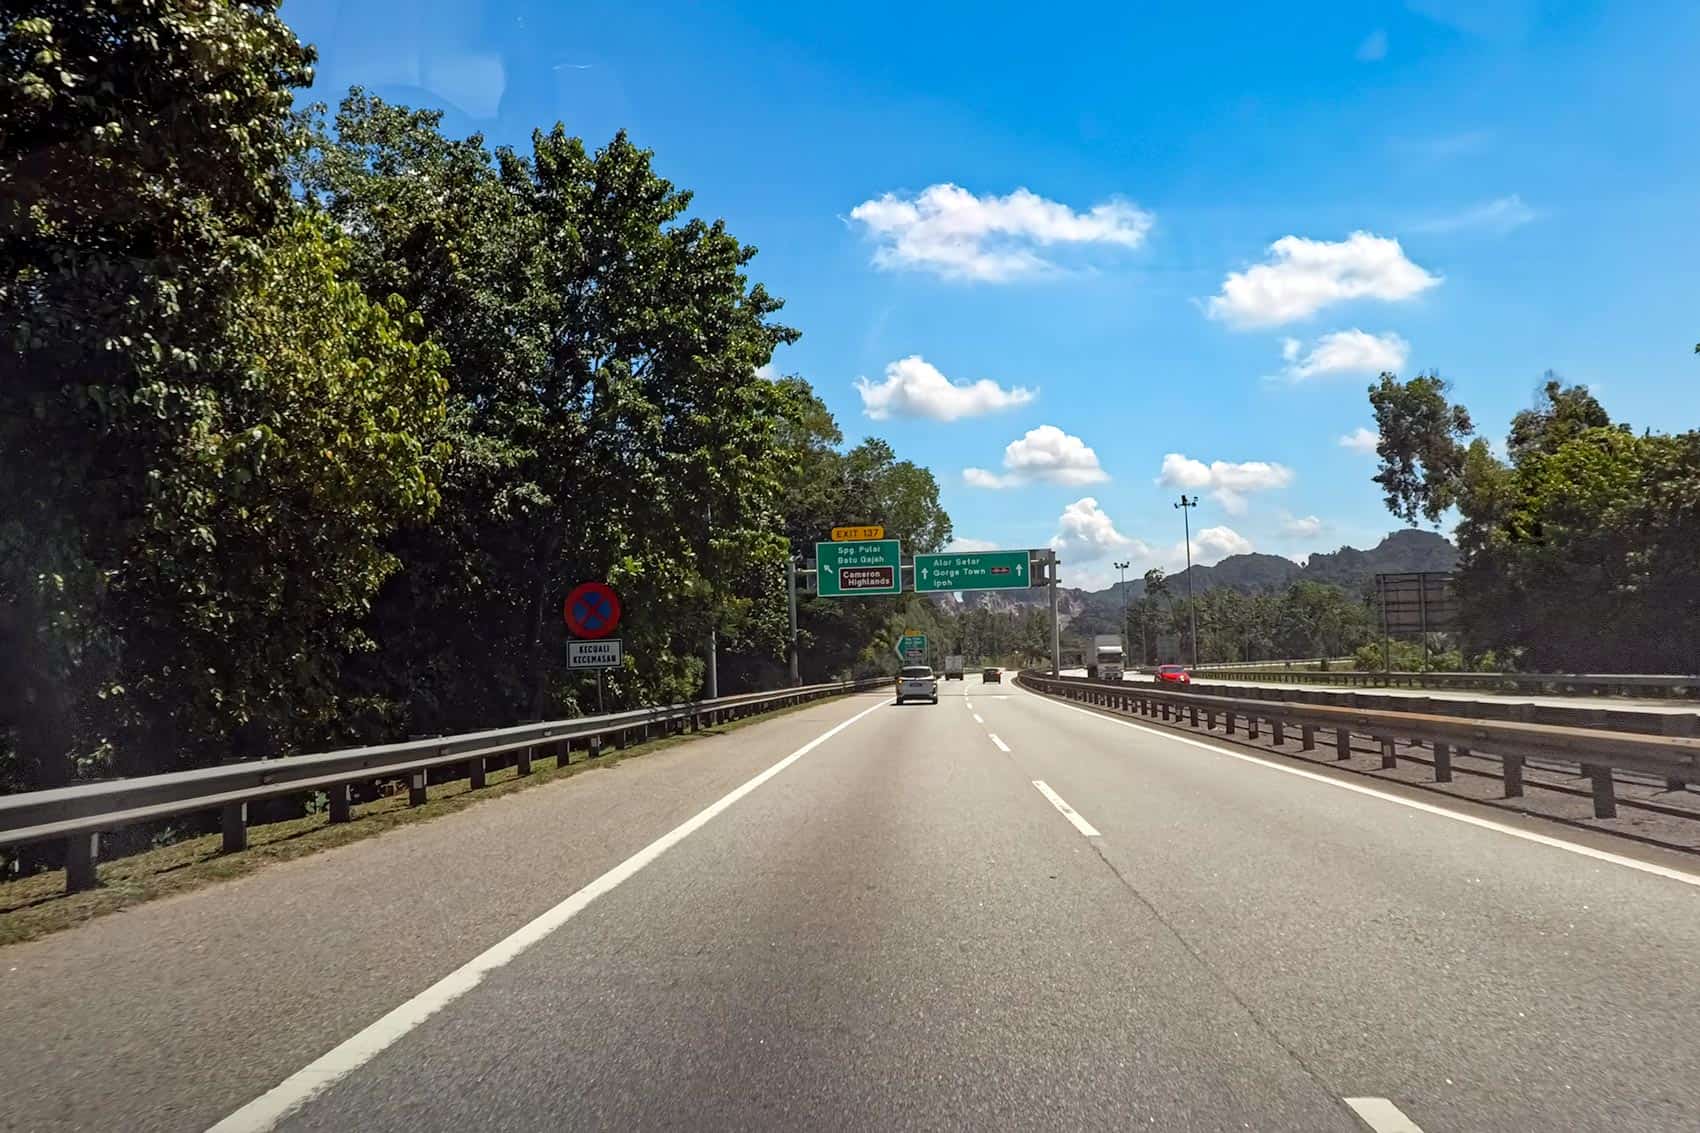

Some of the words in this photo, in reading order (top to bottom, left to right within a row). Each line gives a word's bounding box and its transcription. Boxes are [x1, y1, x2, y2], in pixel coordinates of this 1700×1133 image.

[837, 530, 858, 538] EXIT
[860, 556, 884, 564] Gajah
[848, 578, 890, 586] Highlands
[934, 580, 952, 588] Ipoh
[579, 645, 610, 653] KECUALI
[573, 655, 616, 664] KECEMASAN
